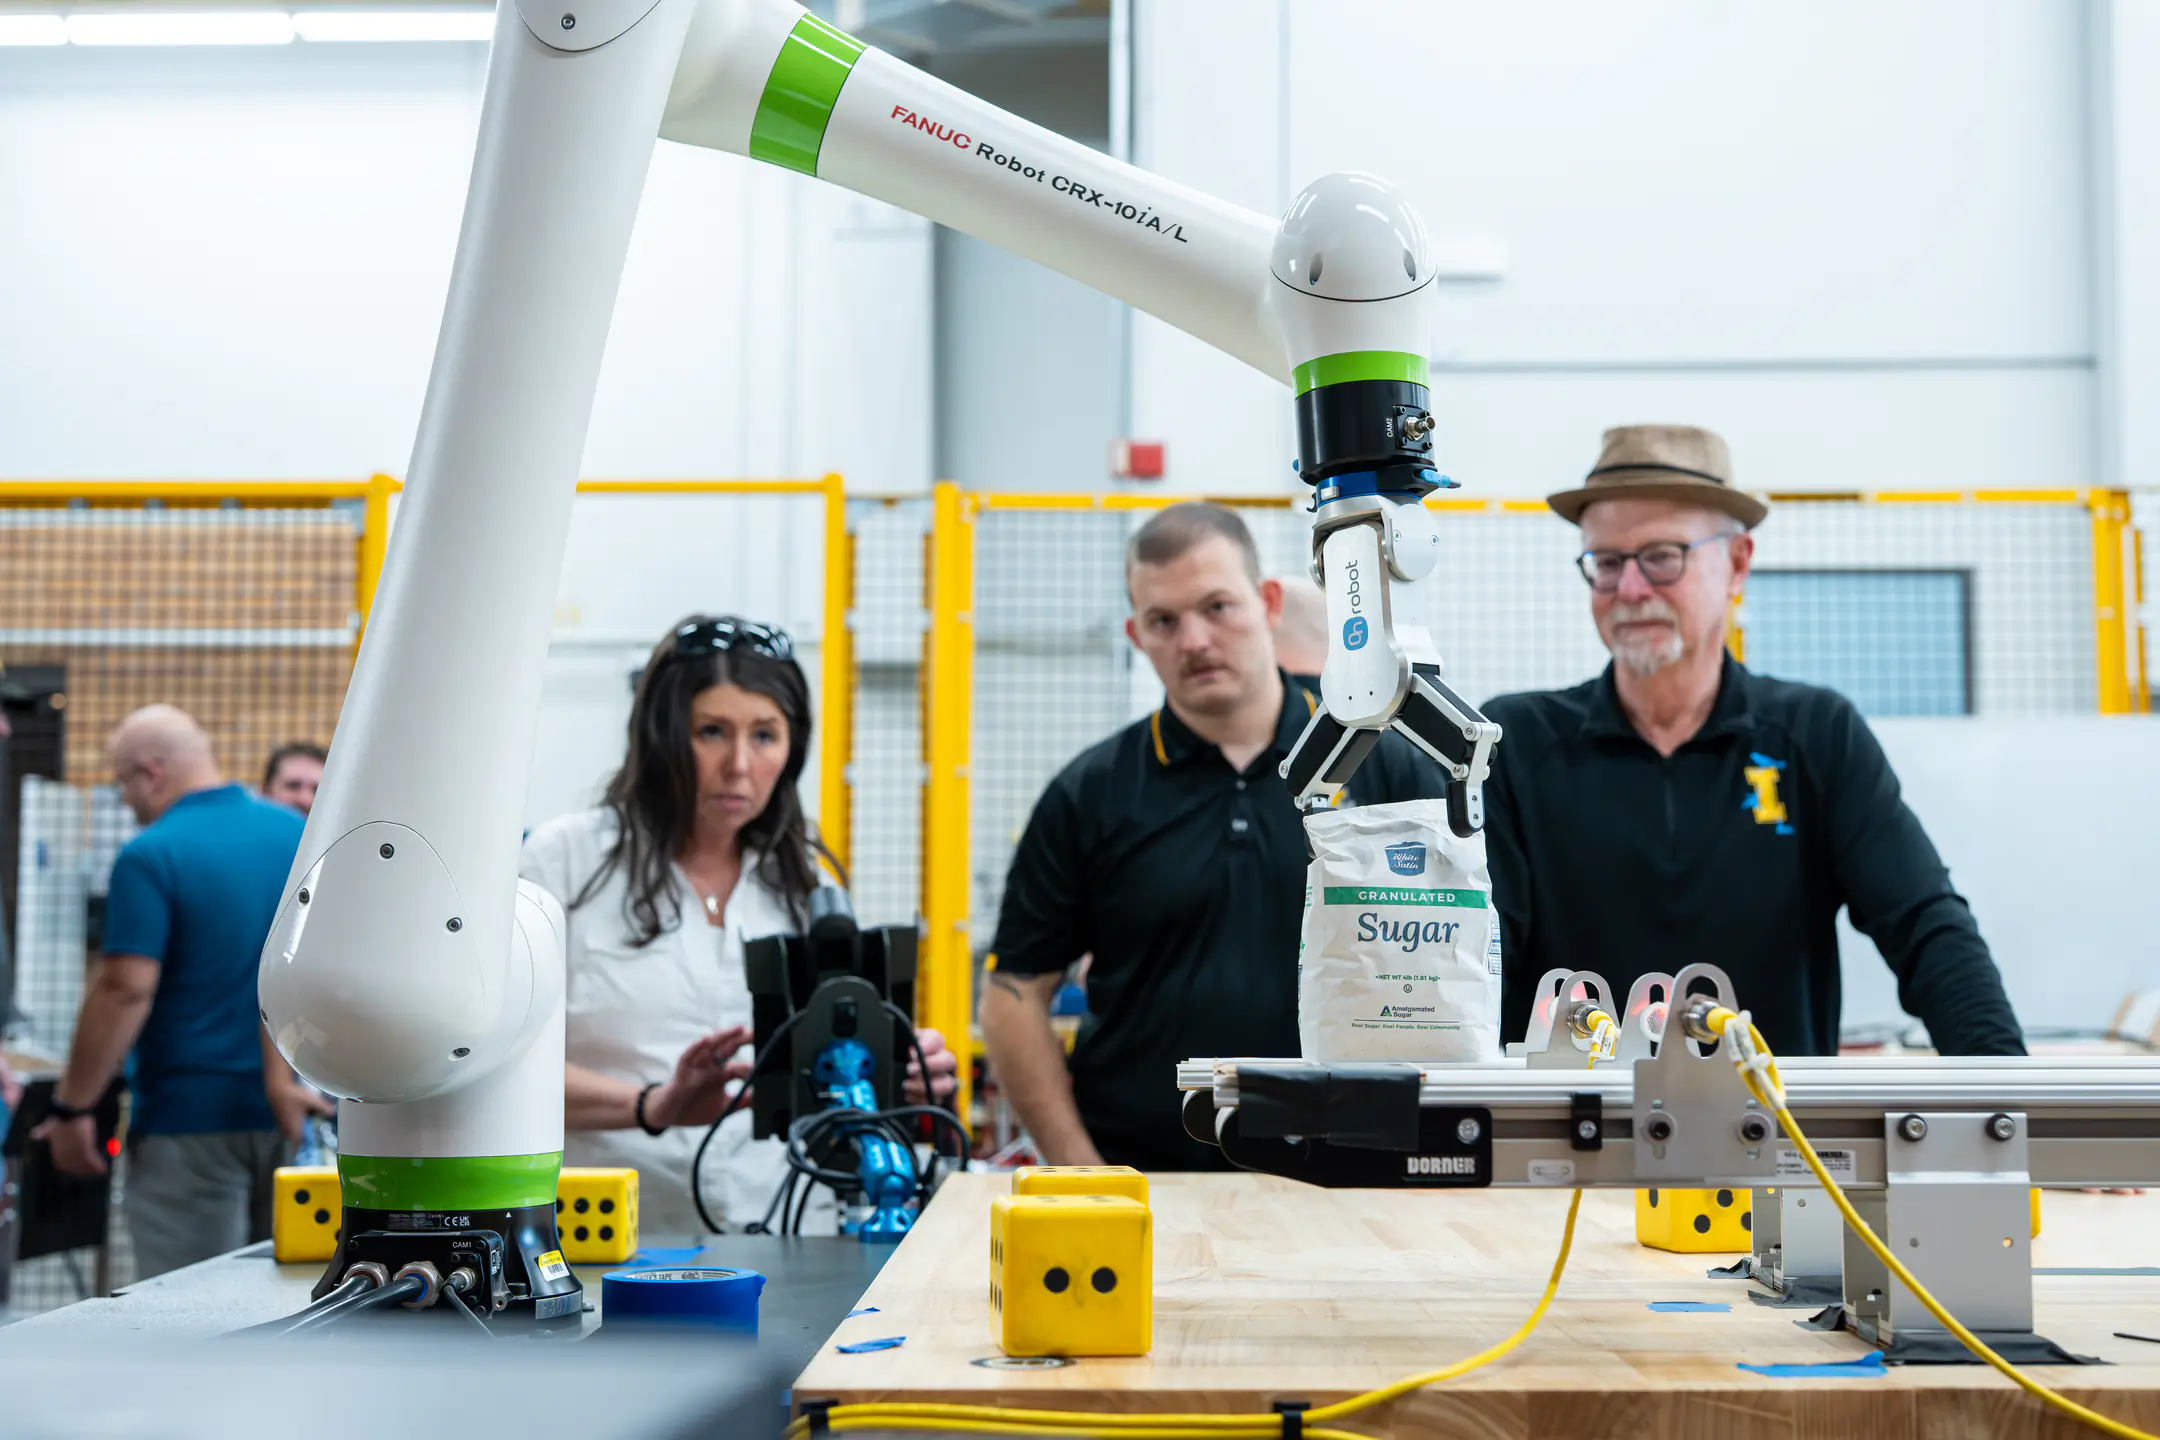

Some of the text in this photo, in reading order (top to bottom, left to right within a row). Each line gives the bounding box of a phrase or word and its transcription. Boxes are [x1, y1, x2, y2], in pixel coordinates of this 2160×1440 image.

[890, 105, 1189, 244] FANUC Robot CRX-10iA/L
[1385, 417, 1393, 438] CAM2
[1392, 852, 1420, 861] White
[1393, 860, 1419, 870] Satin
[1358, 891, 1456, 903] GRANULATED
[1357, 912, 1460, 953] Sugar
[1407, 1156, 1476, 1174] DORNER
[452, 1241, 472, 1249] CAM1
